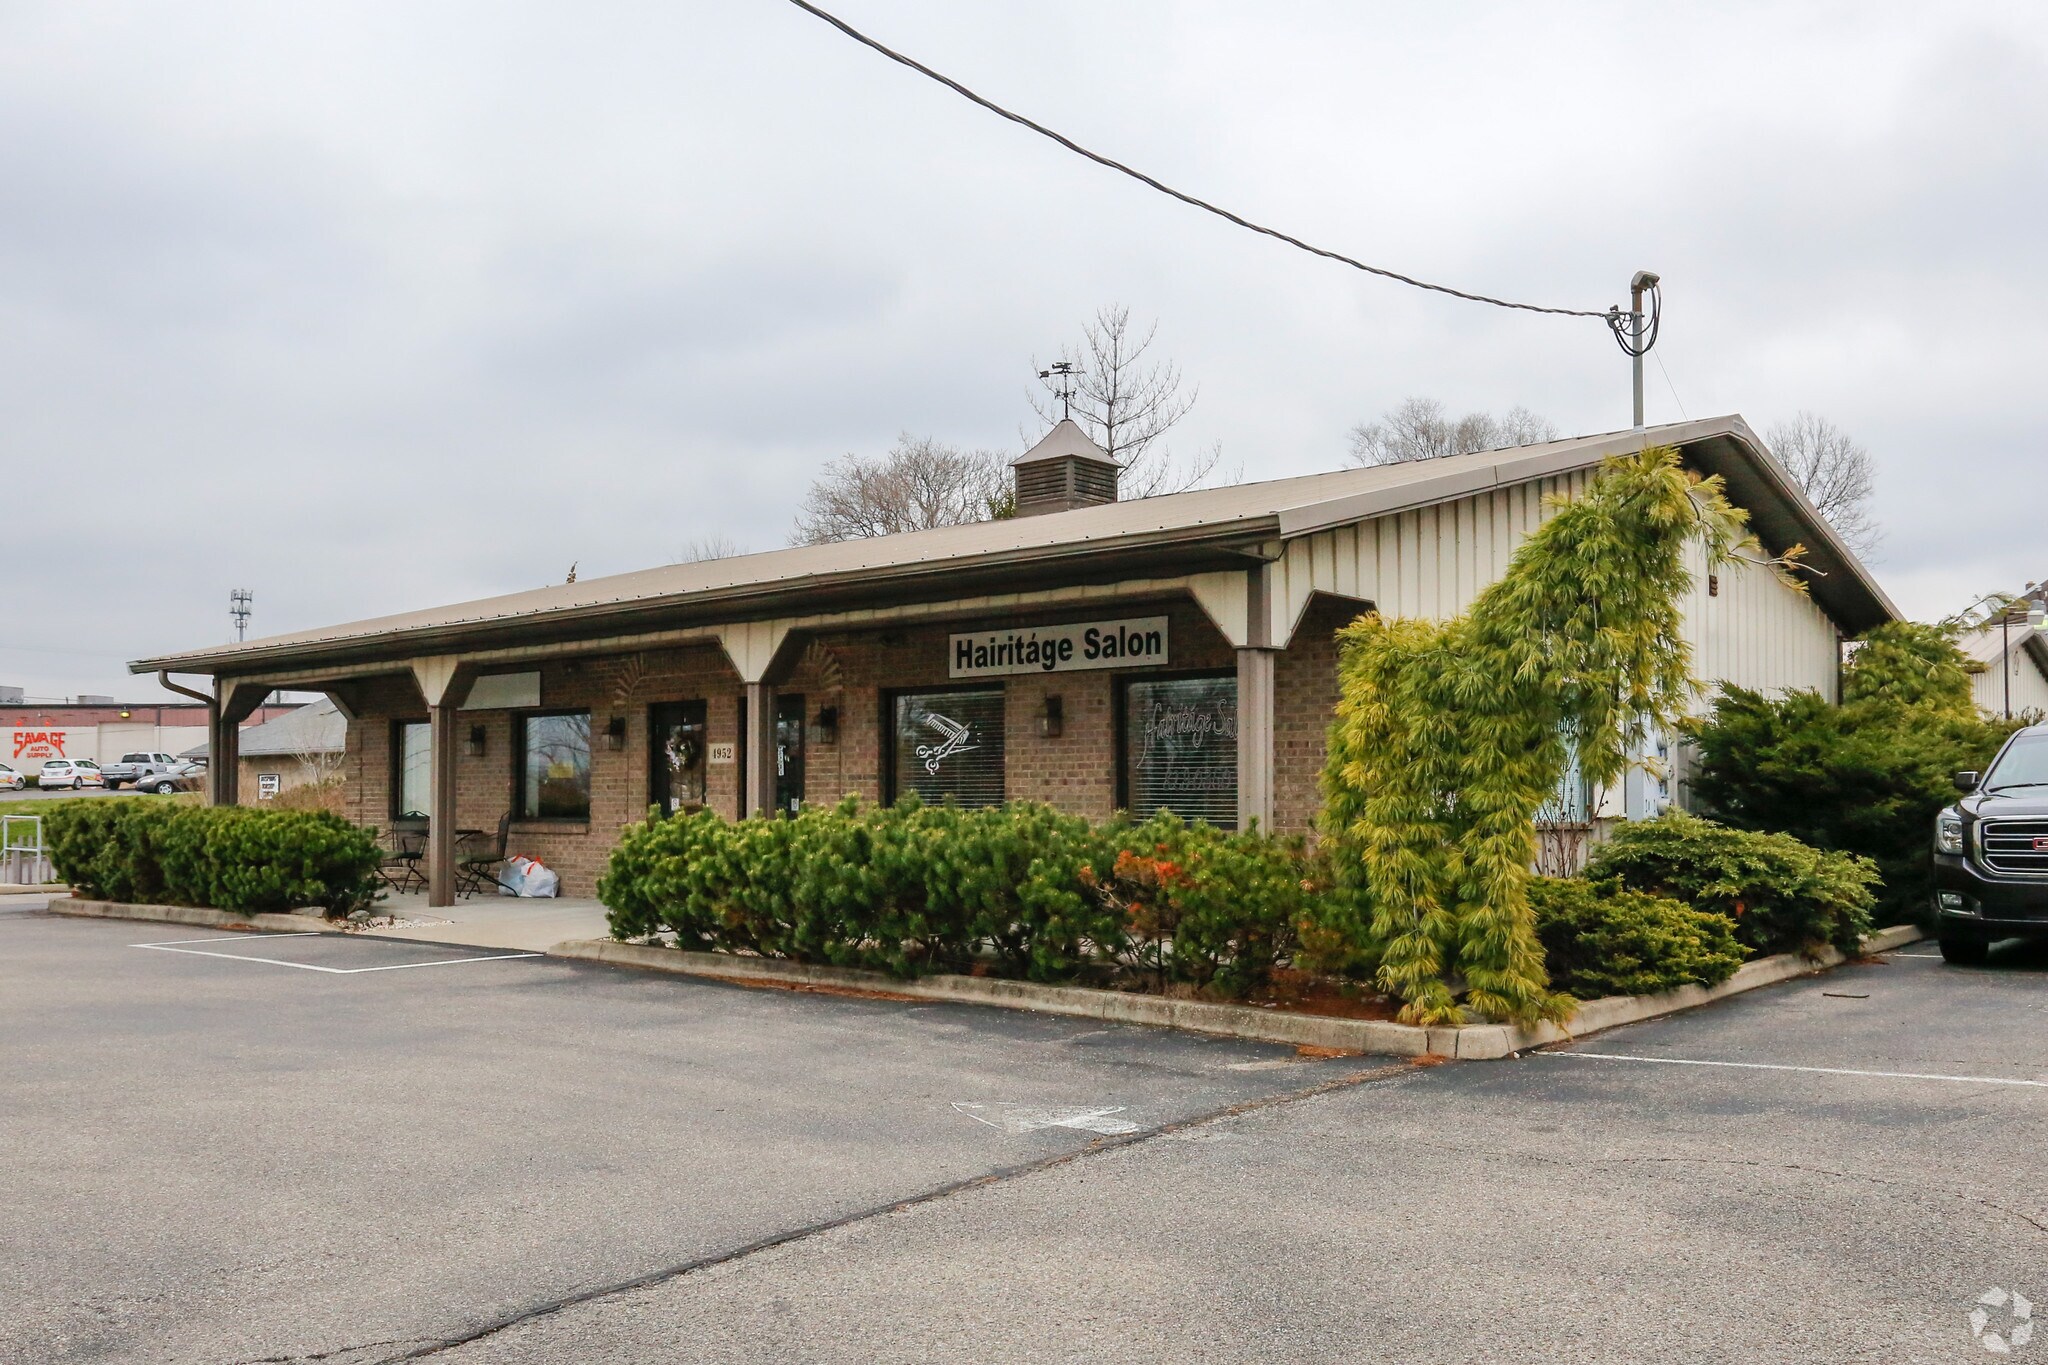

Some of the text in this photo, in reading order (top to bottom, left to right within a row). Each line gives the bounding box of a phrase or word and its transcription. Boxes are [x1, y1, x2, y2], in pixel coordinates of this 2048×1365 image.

[956, 626, 1161, 671] Hairitáge Salon
[1213, 699, 1238, 740] Sal
[13, 731, 66, 759] SAVAGE
